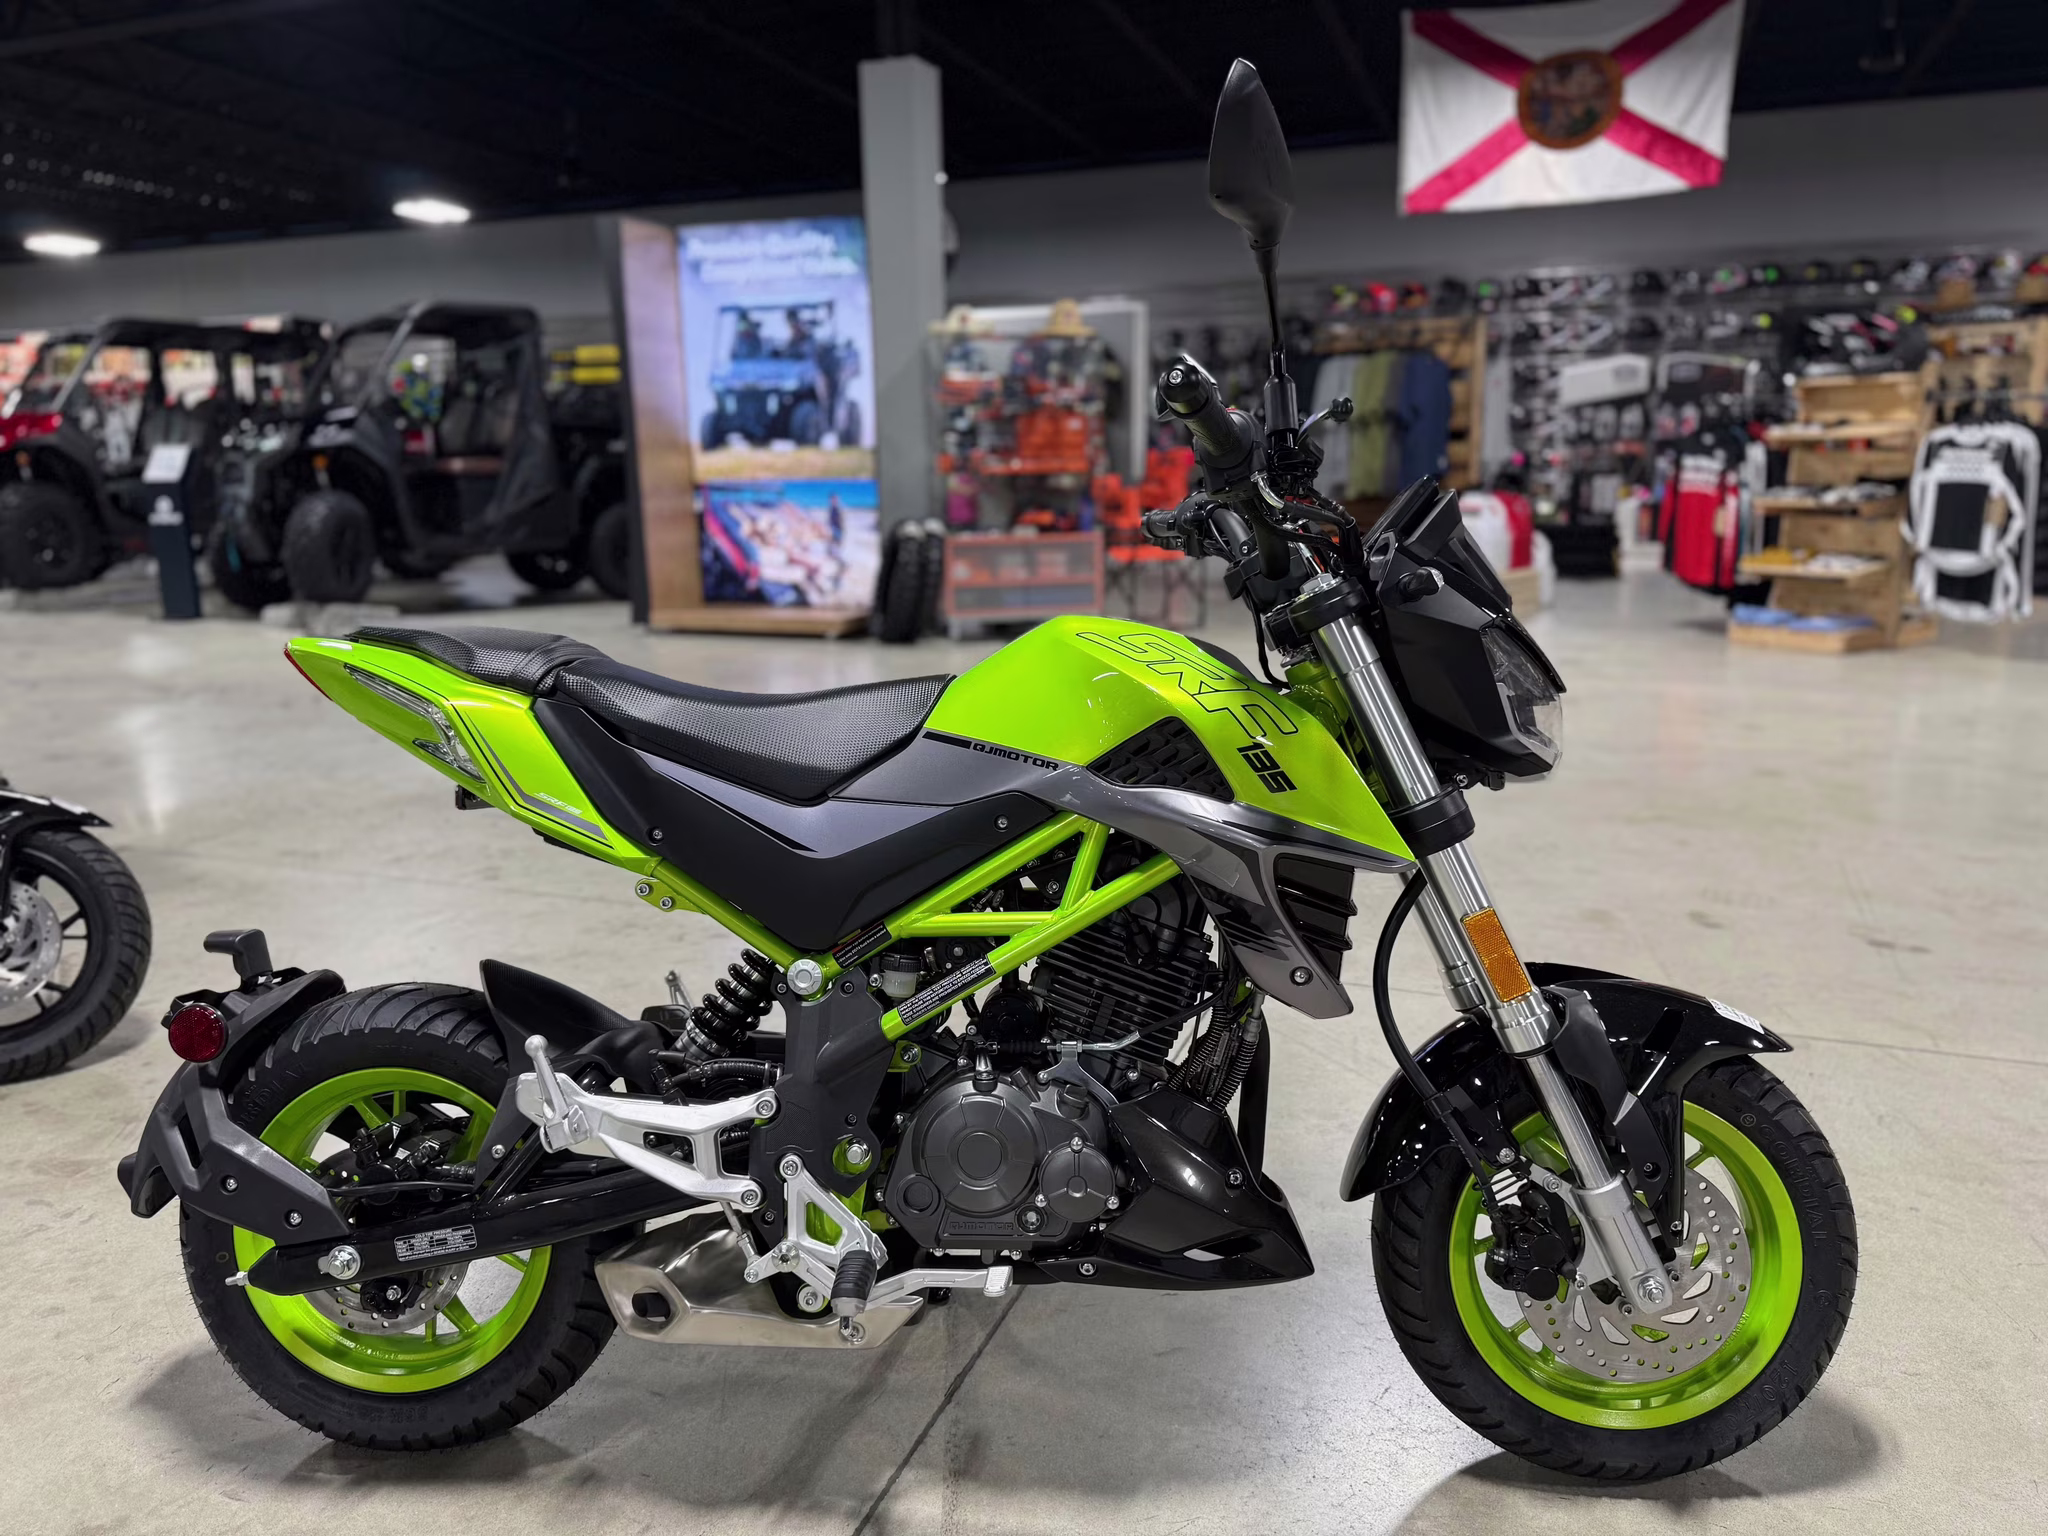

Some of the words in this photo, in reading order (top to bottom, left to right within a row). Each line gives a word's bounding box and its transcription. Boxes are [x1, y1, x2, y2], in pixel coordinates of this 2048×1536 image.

[972, 742, 1060, 771] QJMOTOR
[1076, 632, 1298, 739] SRF
[1236, 741, 1298, 794] 135
